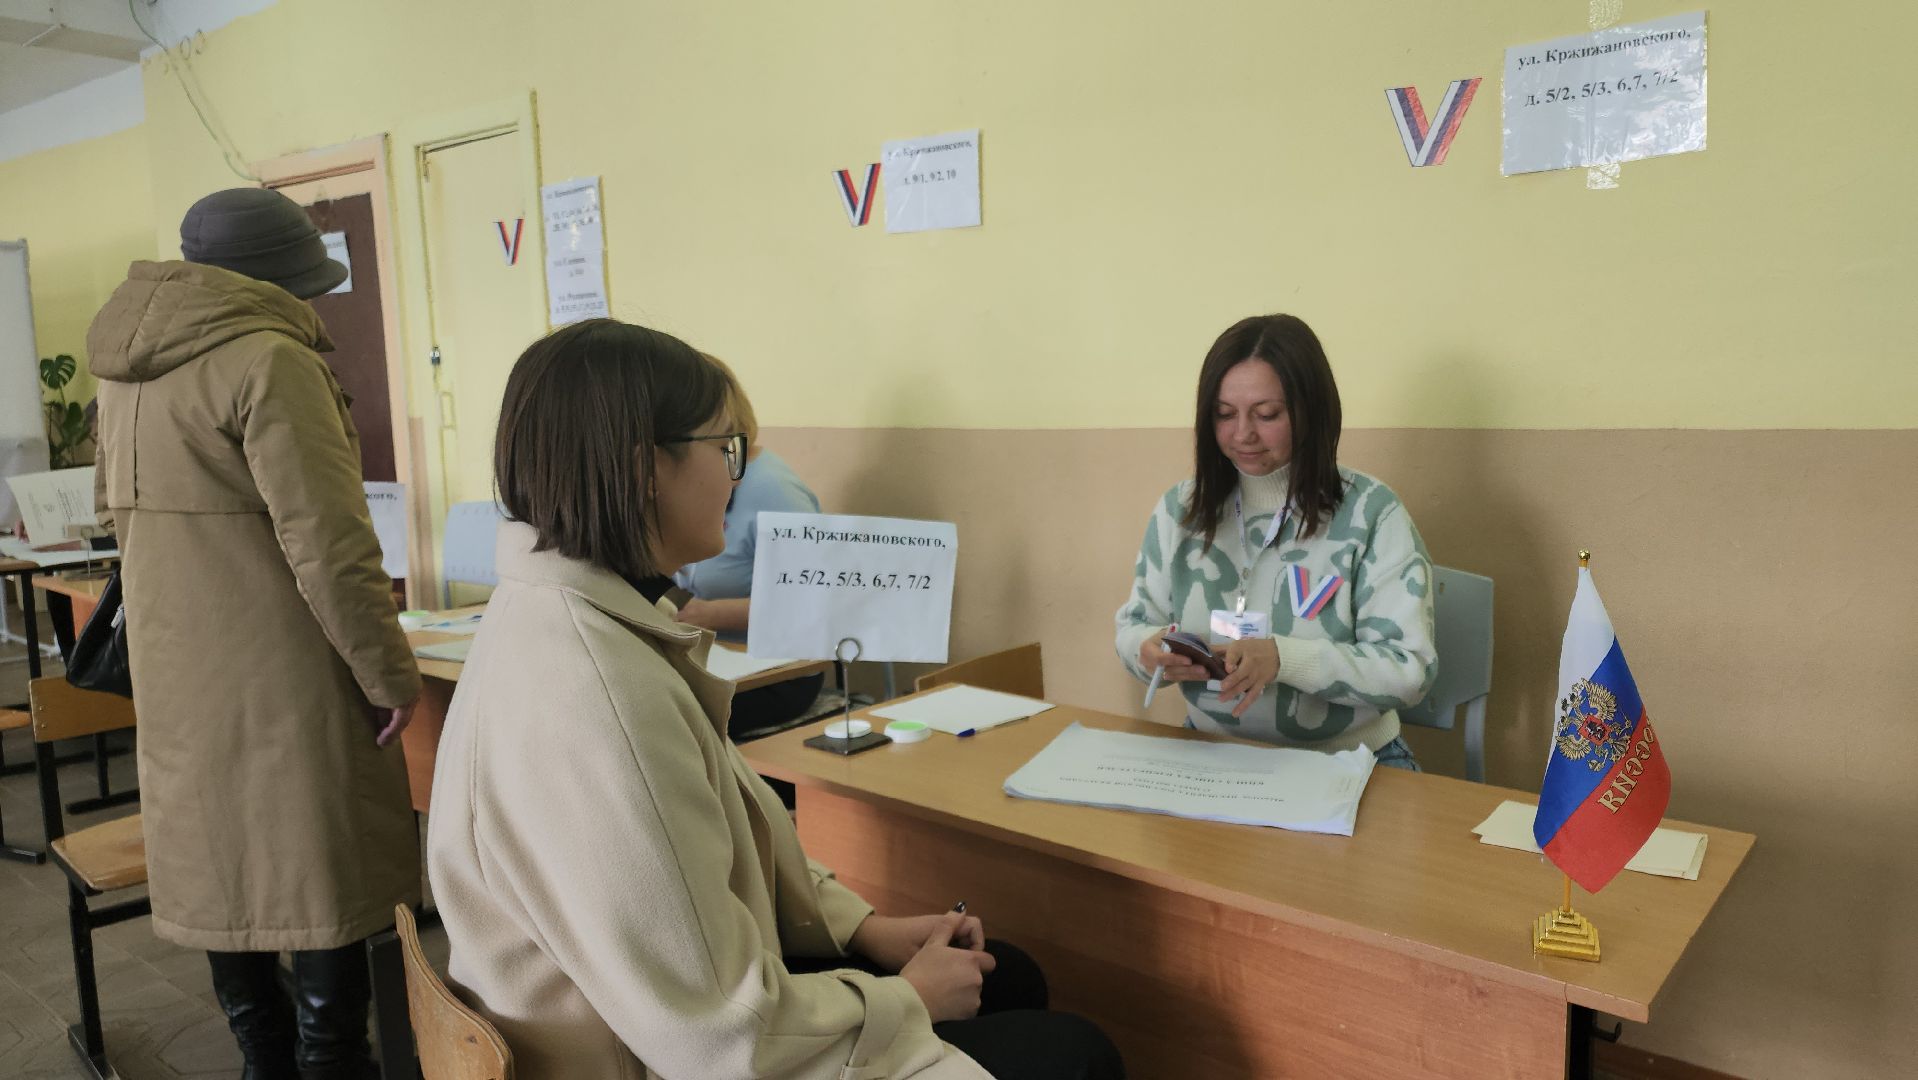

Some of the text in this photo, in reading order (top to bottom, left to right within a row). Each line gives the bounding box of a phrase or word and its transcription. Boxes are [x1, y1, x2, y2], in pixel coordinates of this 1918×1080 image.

[1518, 29, 1691, 70] ул. Кржижановского,
[1524, 94, 1540, 107] д.
[1546, 87, 1576, 103] 5/2,
[772, 526, 946, 549] ул. Кржижановского,
[776, 571, 793, 586] д.
[799, 569, 831, 588] 5/2,
[908, 574, 931, 590] 7/2
